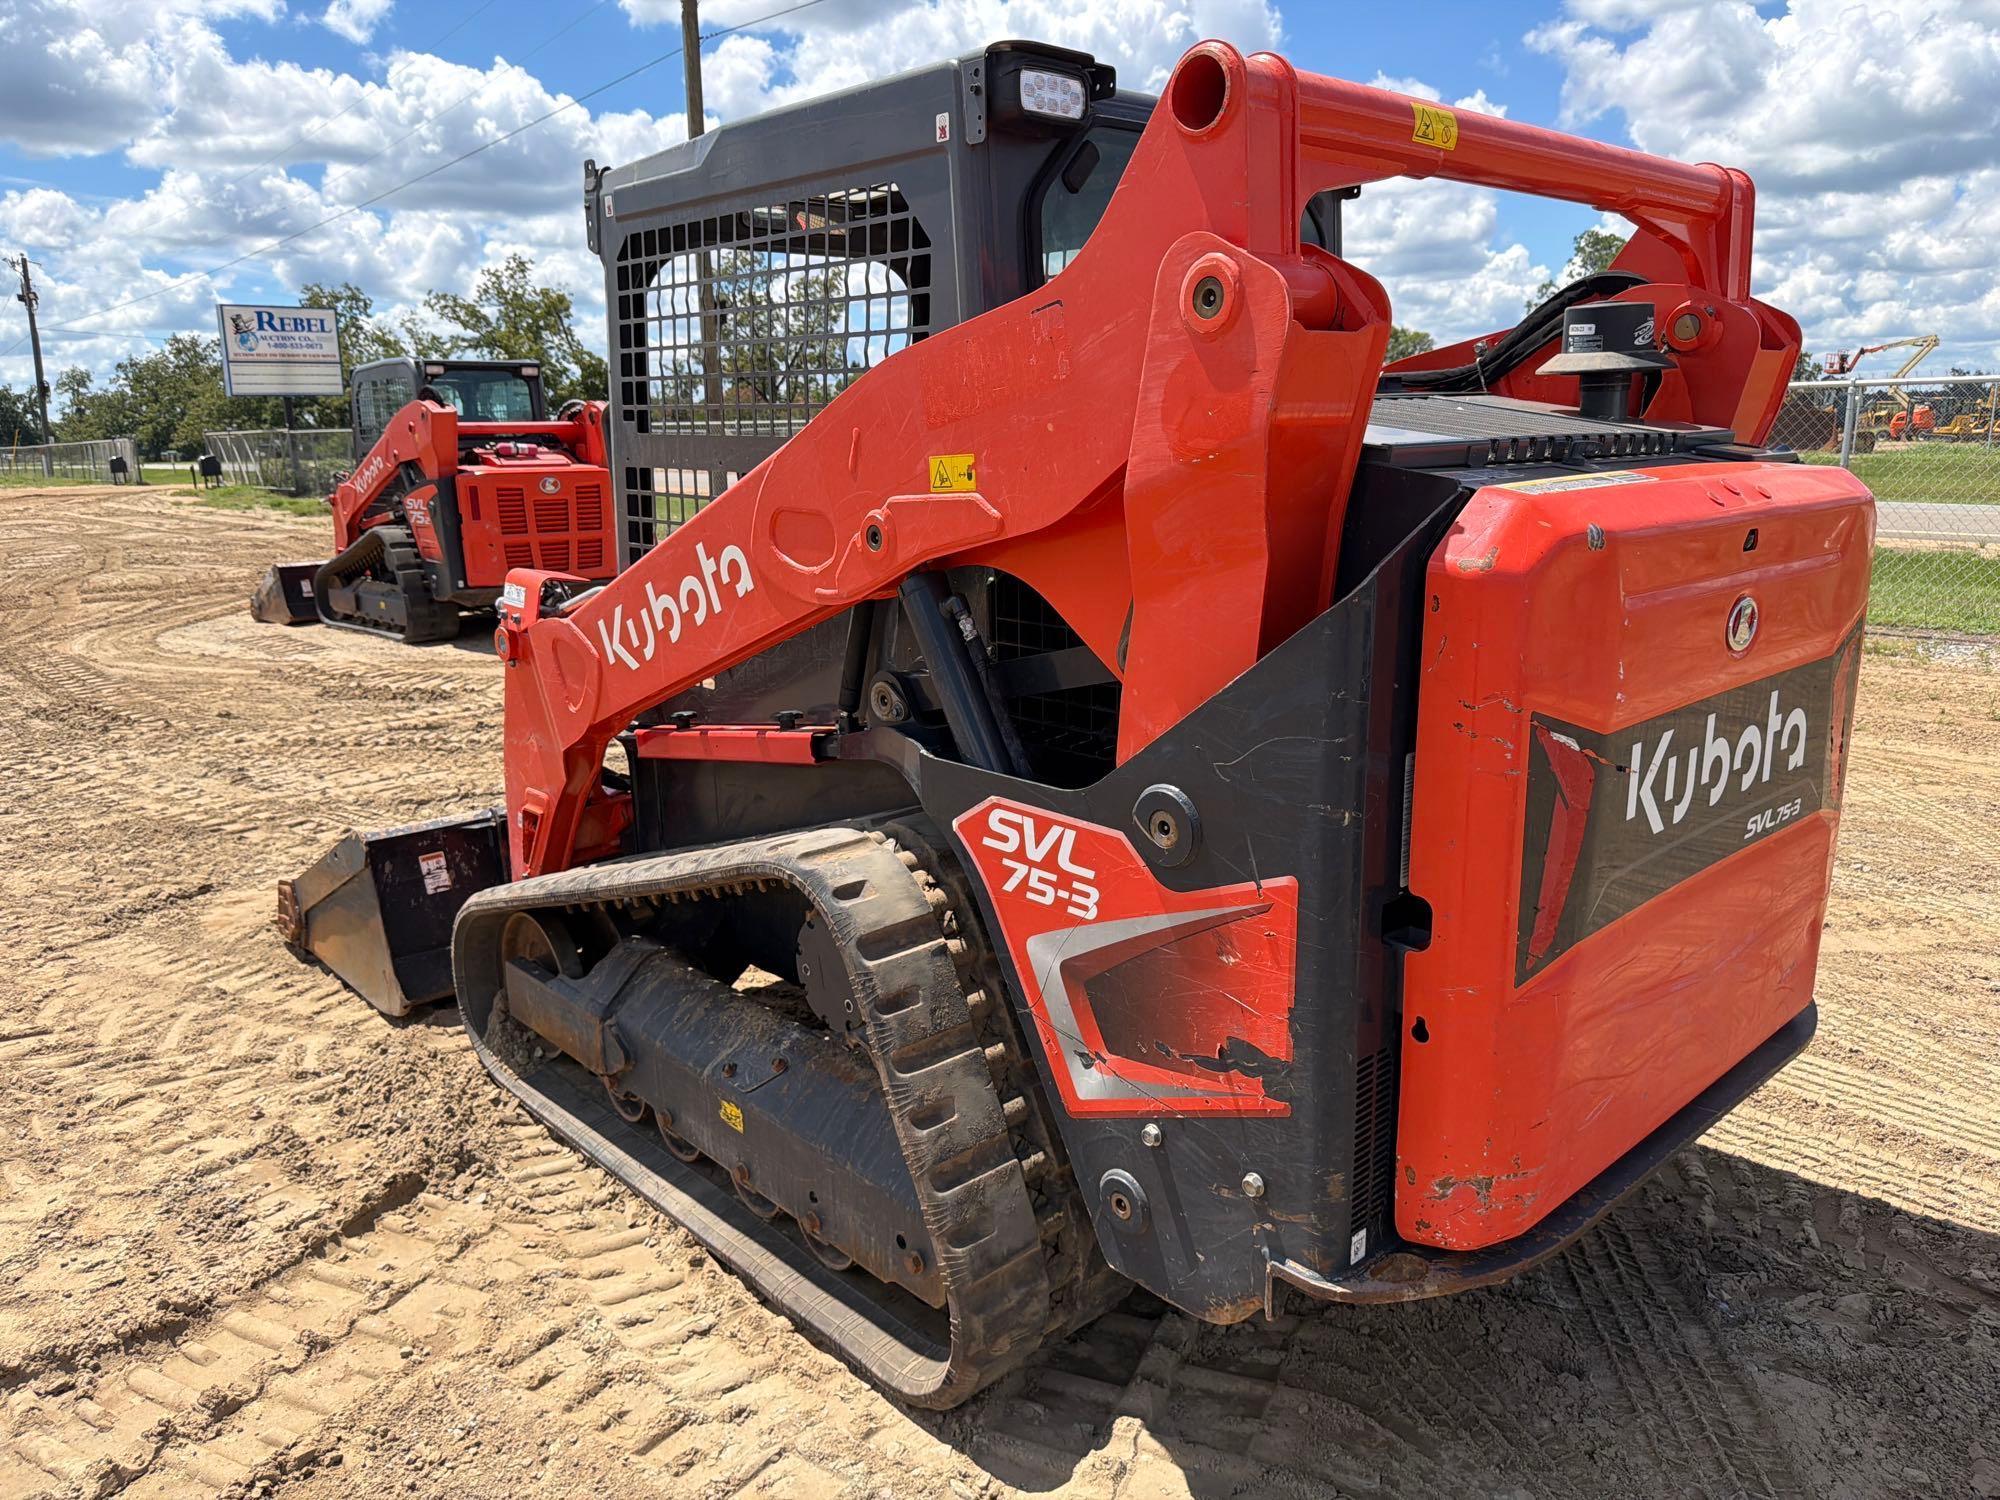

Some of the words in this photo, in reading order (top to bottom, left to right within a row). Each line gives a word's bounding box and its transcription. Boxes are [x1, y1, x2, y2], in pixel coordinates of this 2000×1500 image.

[255, 310, 333, 334] REBEL
[354, 456, 384, 494] Kubota
[406, 498, 427, 510] SVL
[597, 541, 755, 671] Kubota
[1625, 690, 1807, 835] Kubota
[982, 808, 1096, 880] SVL
[1002, 857, 1100, 920] 75-3
